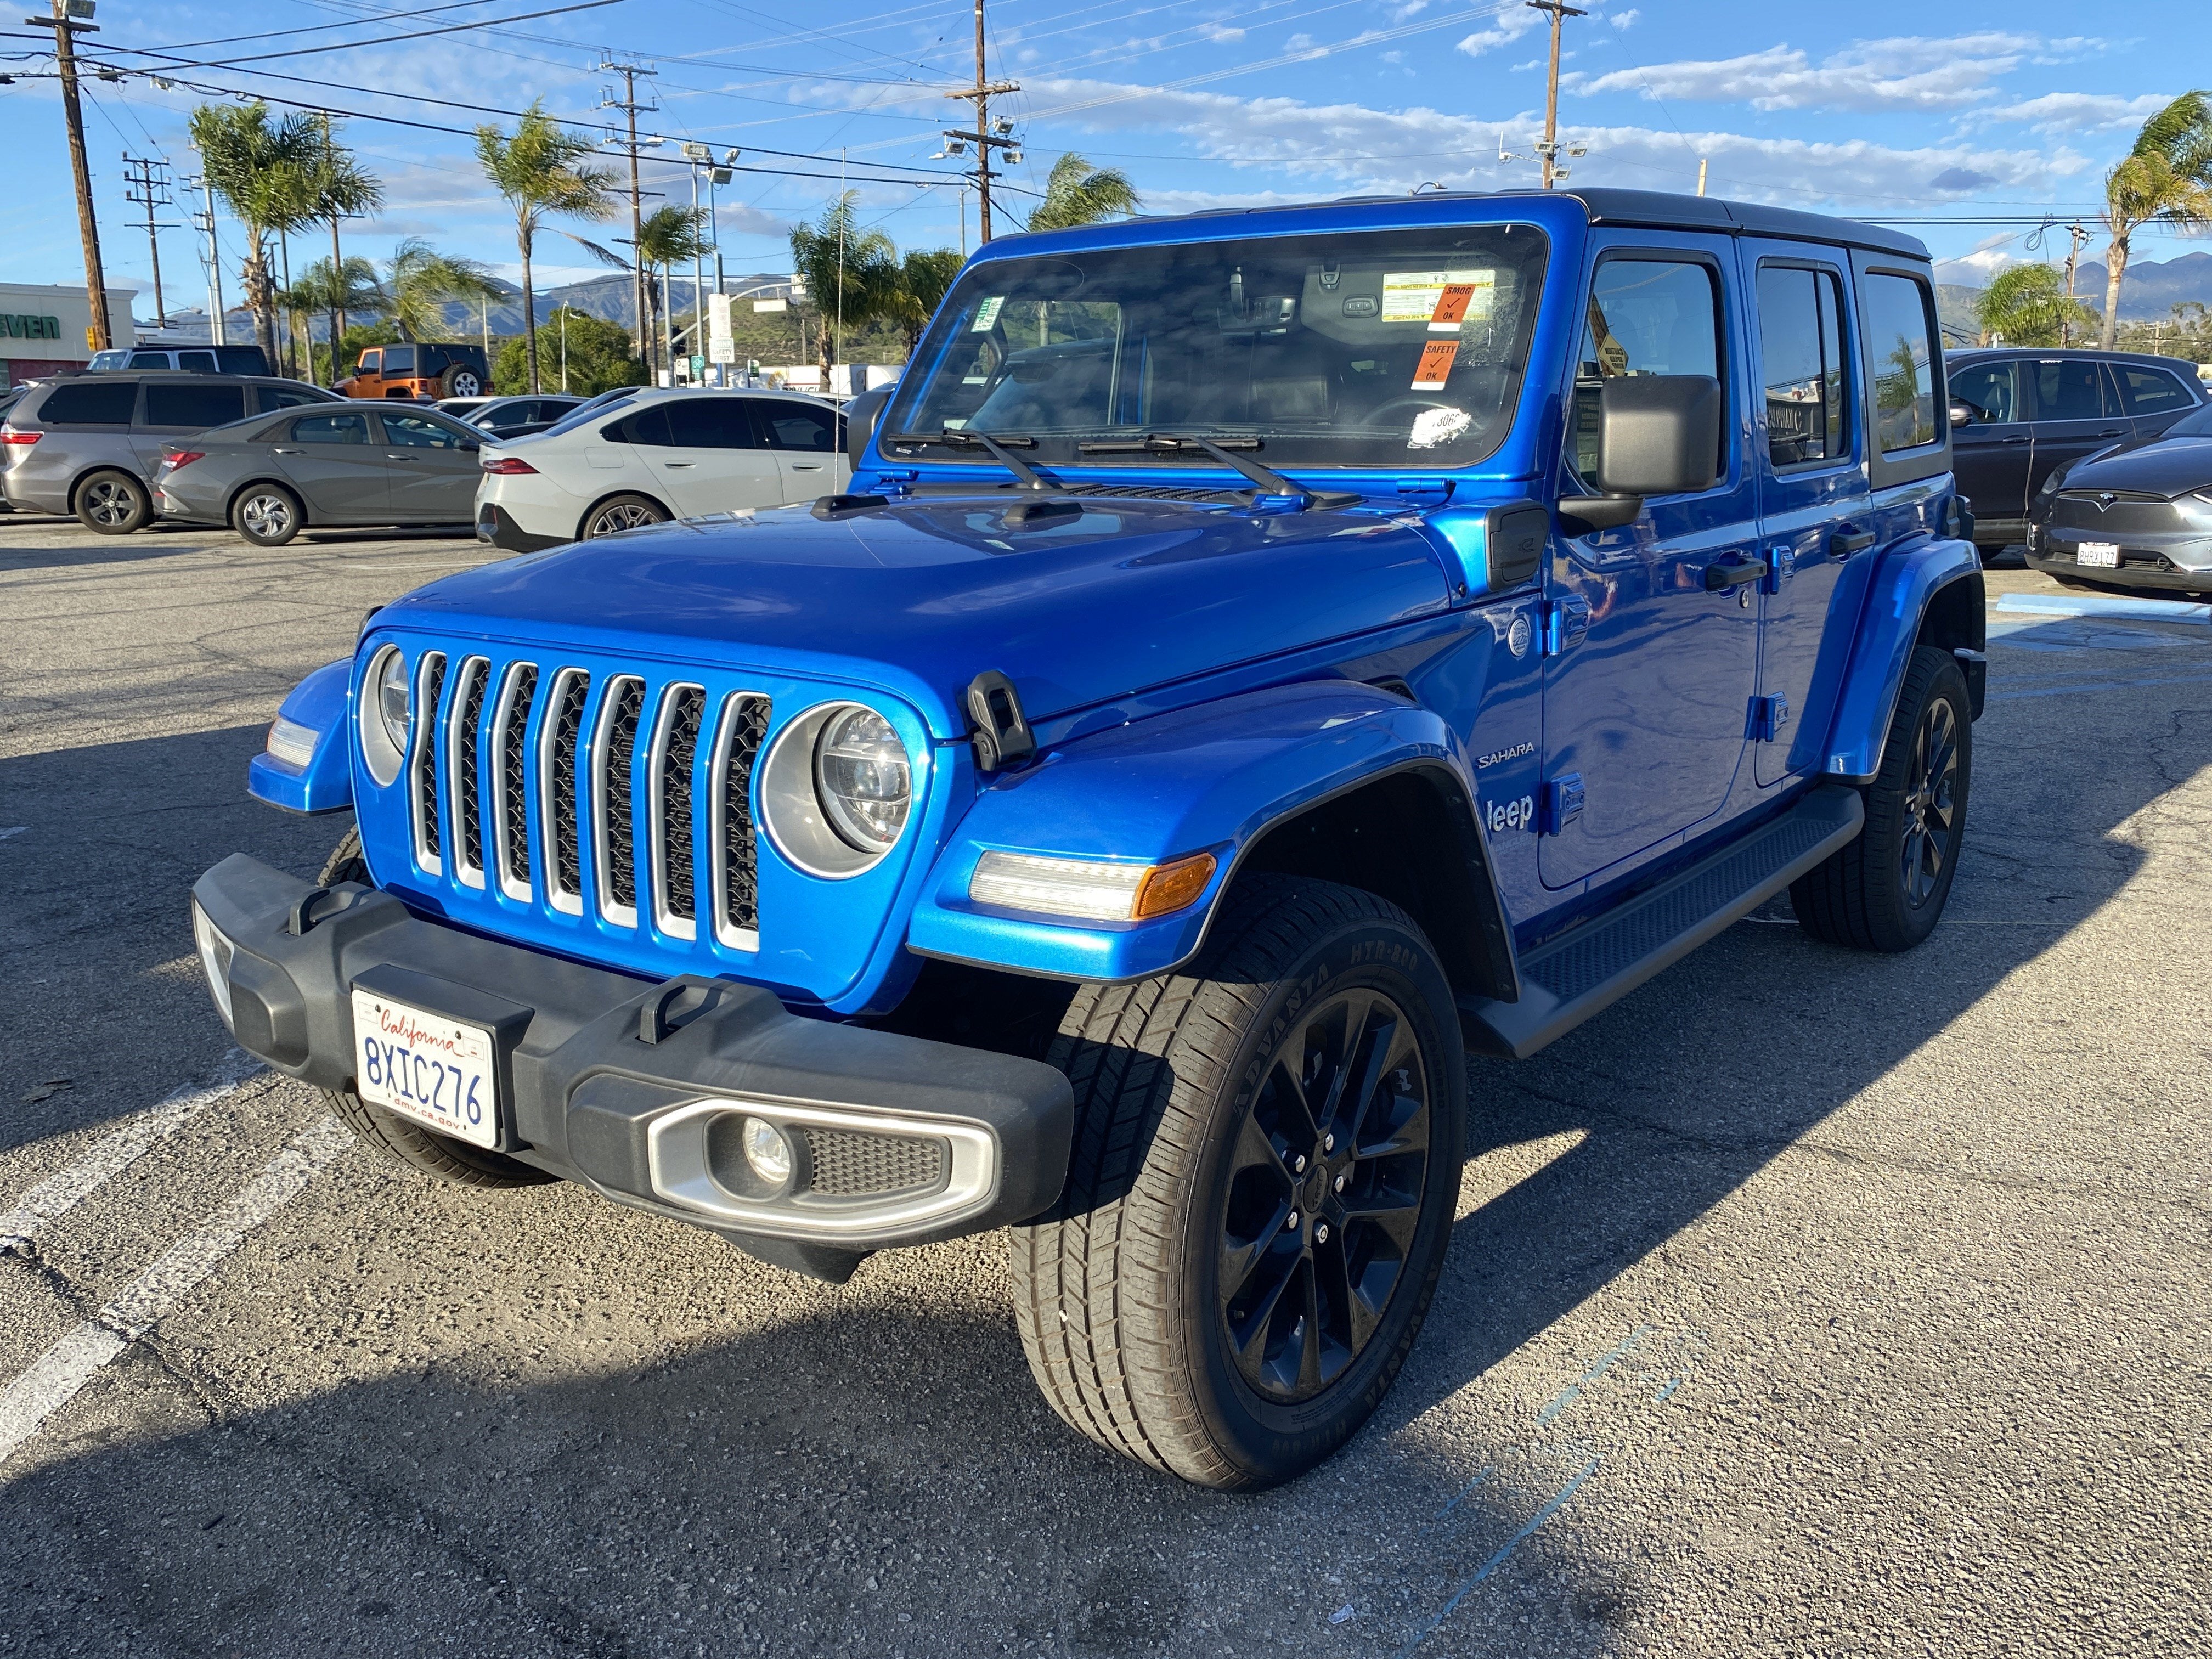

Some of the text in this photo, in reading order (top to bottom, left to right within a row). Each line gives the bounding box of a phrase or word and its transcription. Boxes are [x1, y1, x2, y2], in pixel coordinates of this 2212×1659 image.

[1443, 312, 1454, 320] OK
[1426, 346, 1456, 354] SAFETY
[2079, 550, 2114, 565] 8HRX177
[1479, 742, 1534, 769] SAHARA
[1487, 795, 1533, 832] Jeep
[381, 1009, 465, 1057] California
[1235, 940, 1418, 1118] ADVANTA HTR-800
[364, 1036, 481, 1125] 8XIC276
[394, 1098, 460, 1130] dmv.ca.gov
[1312, 1169, 1324, 1207] Jeep
